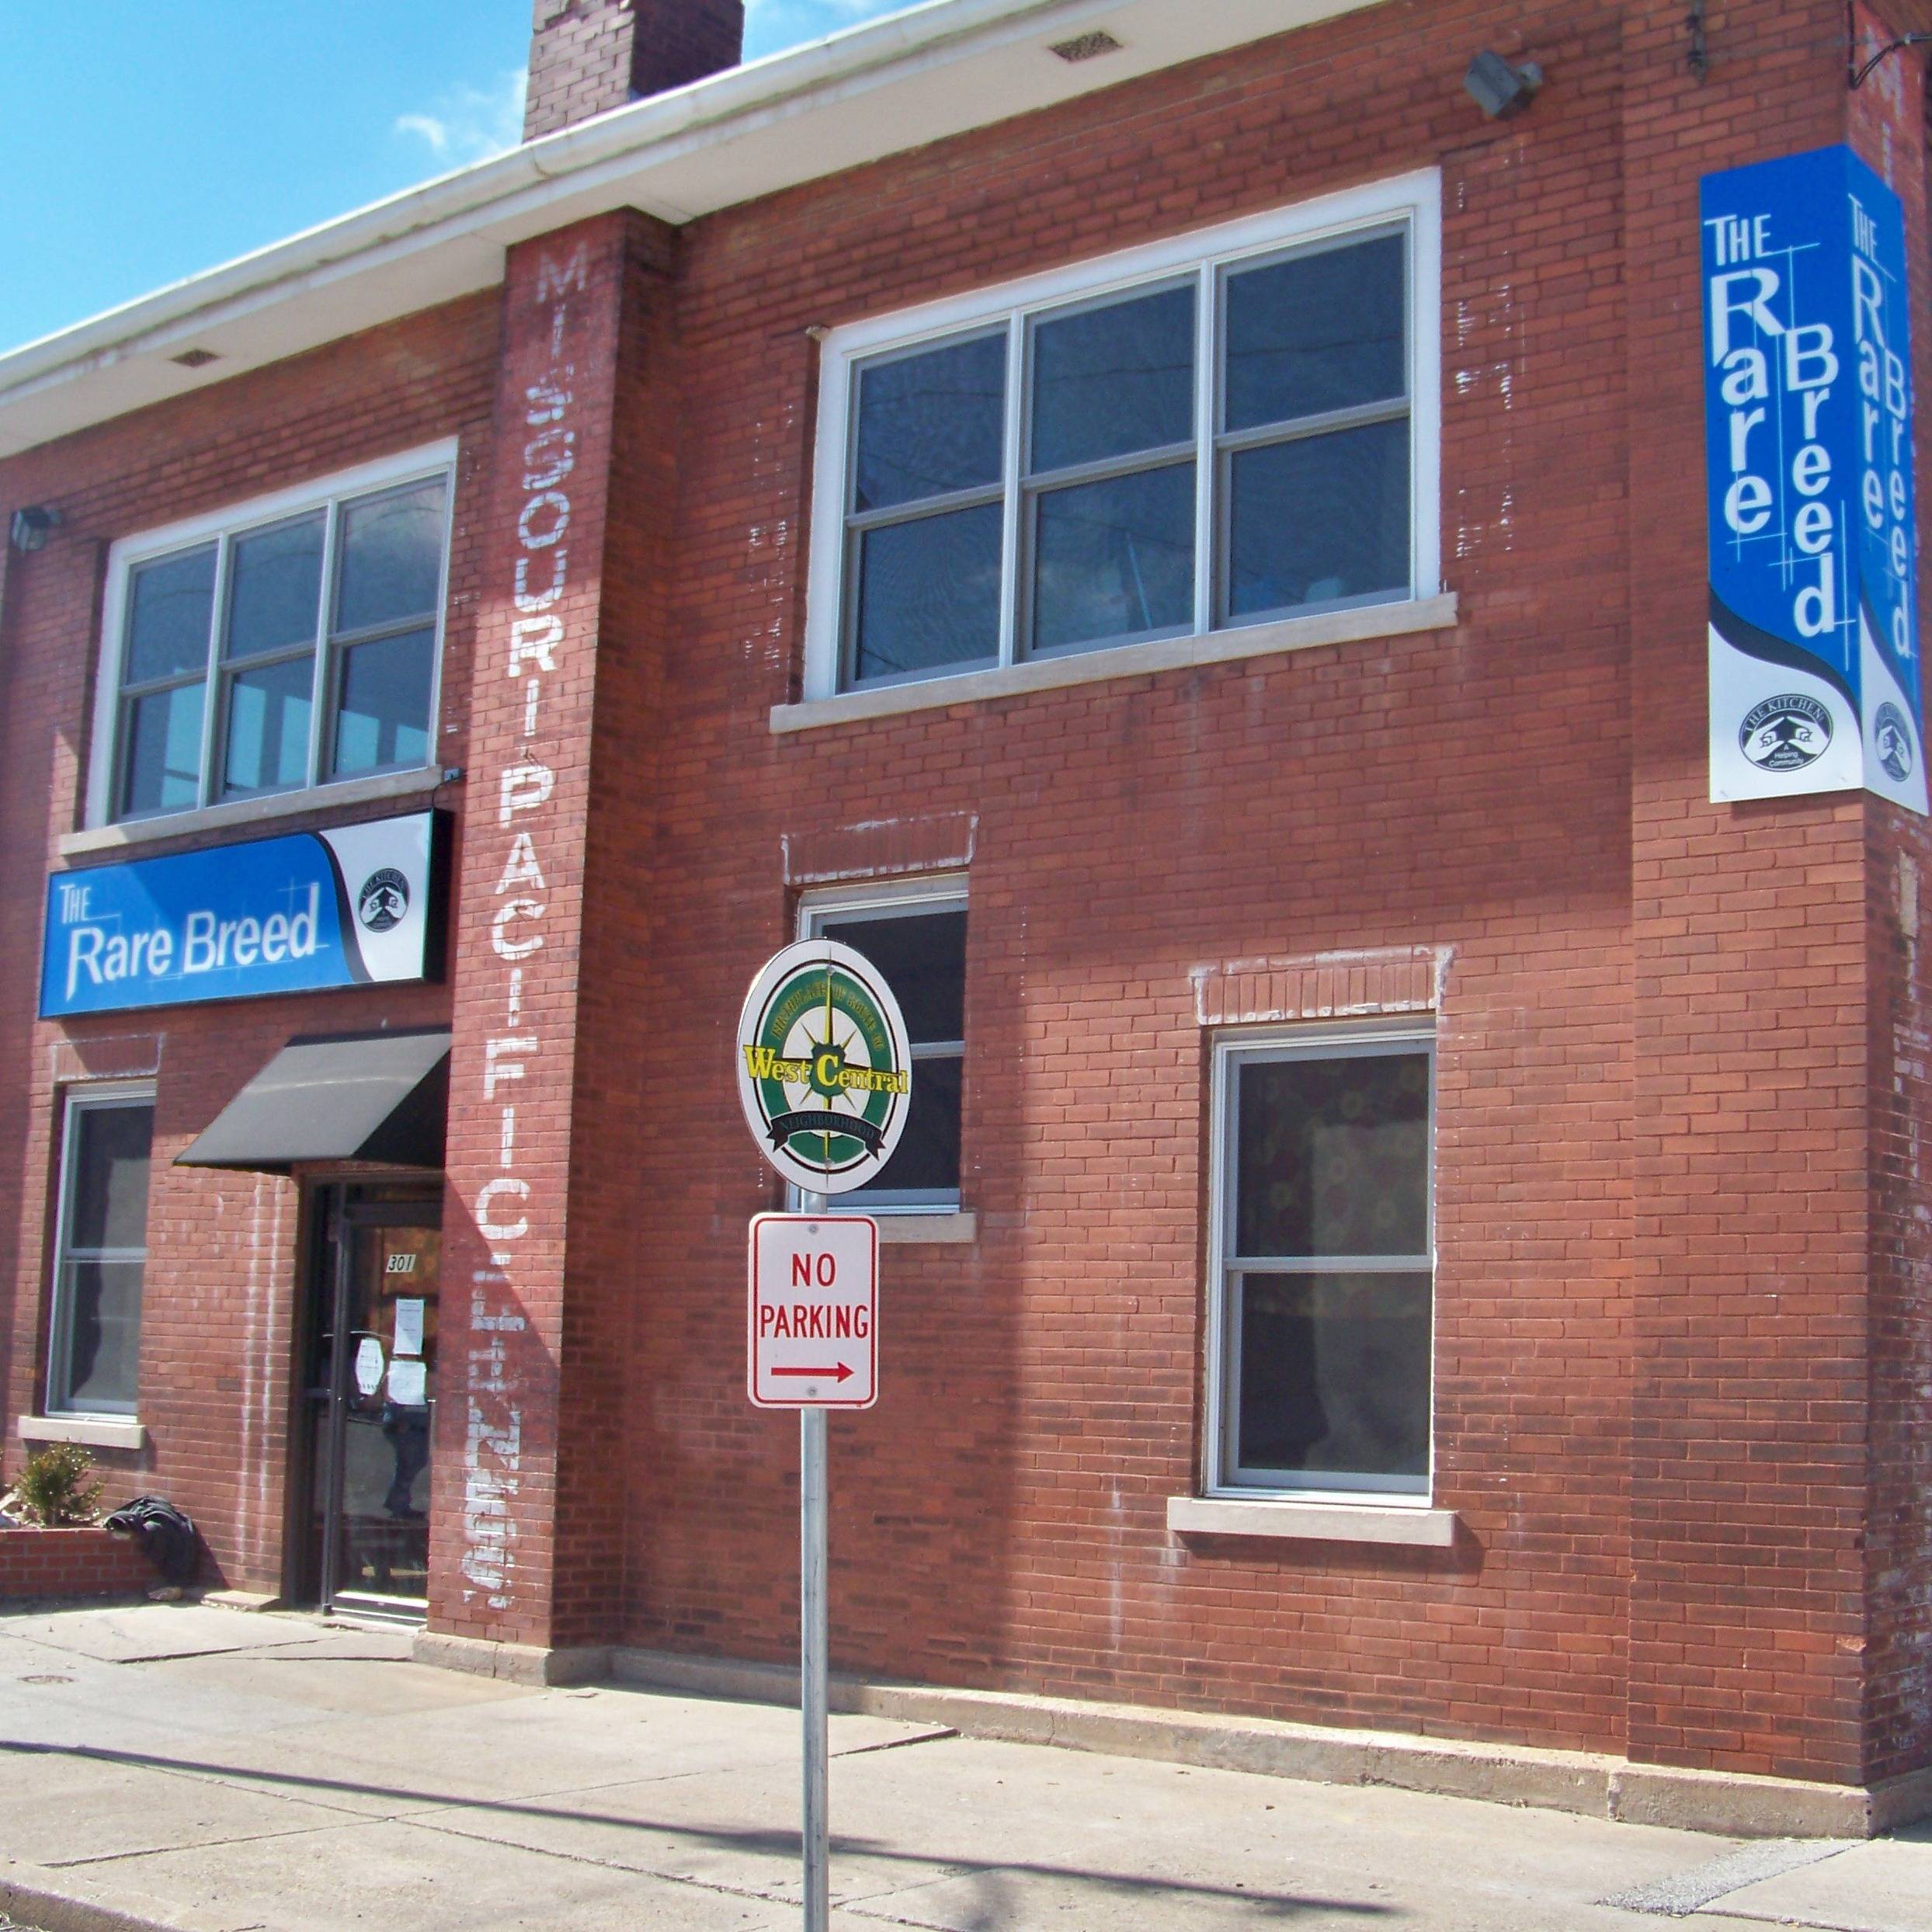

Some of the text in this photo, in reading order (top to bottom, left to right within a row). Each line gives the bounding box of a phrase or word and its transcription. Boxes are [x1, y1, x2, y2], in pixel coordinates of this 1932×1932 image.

[1711, 268, 1786, 534] Rare
[1852, 253, 1885, 530] Rare
[507, 240, 588, 737] MISSOURI
[1787, 323, 1839, 638] Breed
[1884, 348, 1910, 658] Breed
[1744, 705, 1766, 731] THE
[66, 882, 320, 1002] Rare Breed
[475, 764, 556, 1241] PACIFIC
[742, 1044, 909, 1095] West Central
[779, 1113, 875, 1138] NEIGHBORHOOD
[388, 1256, 412, 1271] 301
[759, 1305, 869, 1339] PARKING
[791, 1253, 836, 1287] NO
